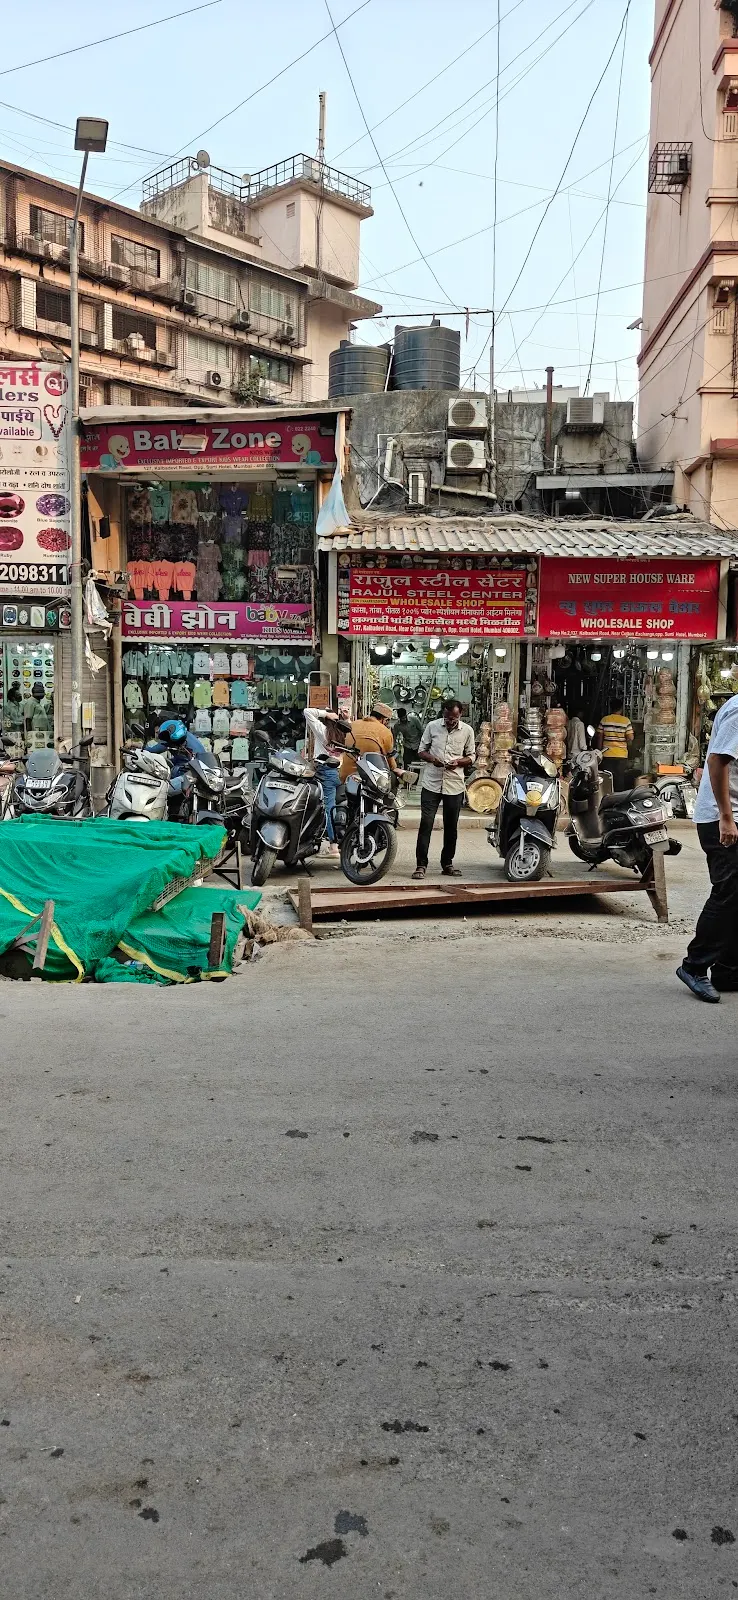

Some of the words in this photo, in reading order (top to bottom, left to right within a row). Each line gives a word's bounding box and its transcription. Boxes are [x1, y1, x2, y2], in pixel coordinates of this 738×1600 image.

[133, 430, 203, 455] Bab
[211, 428, 282, 448] Zone
[353, 574, 412, 589] राजुल
[417, 572, 471, 587] स्टील
[476, 573, 523, 588] सेंटर
[568, 573, 591, 584] NEW
[593, 573, 627, 584] SUPER
[629, 573, 664, 584] HOUSE
[666, 573, 695, 584] WARE
[352, 588, 402, 597] RAJUL
[407, 590, 455, 598] STEEL
[460, 591, 522, 599] CENTER
[390, 598, 453, 606] WHOLESALE
[456, 599, 485, 607] SHOP
[123, 602, 173, 628] बेबी
[180, 603, 239, 630] झोन
[246, 605, 288, 626] baby
[580, 618, 643, 628] WHOLESALE
[646, 619, 675, 629] SHOP
